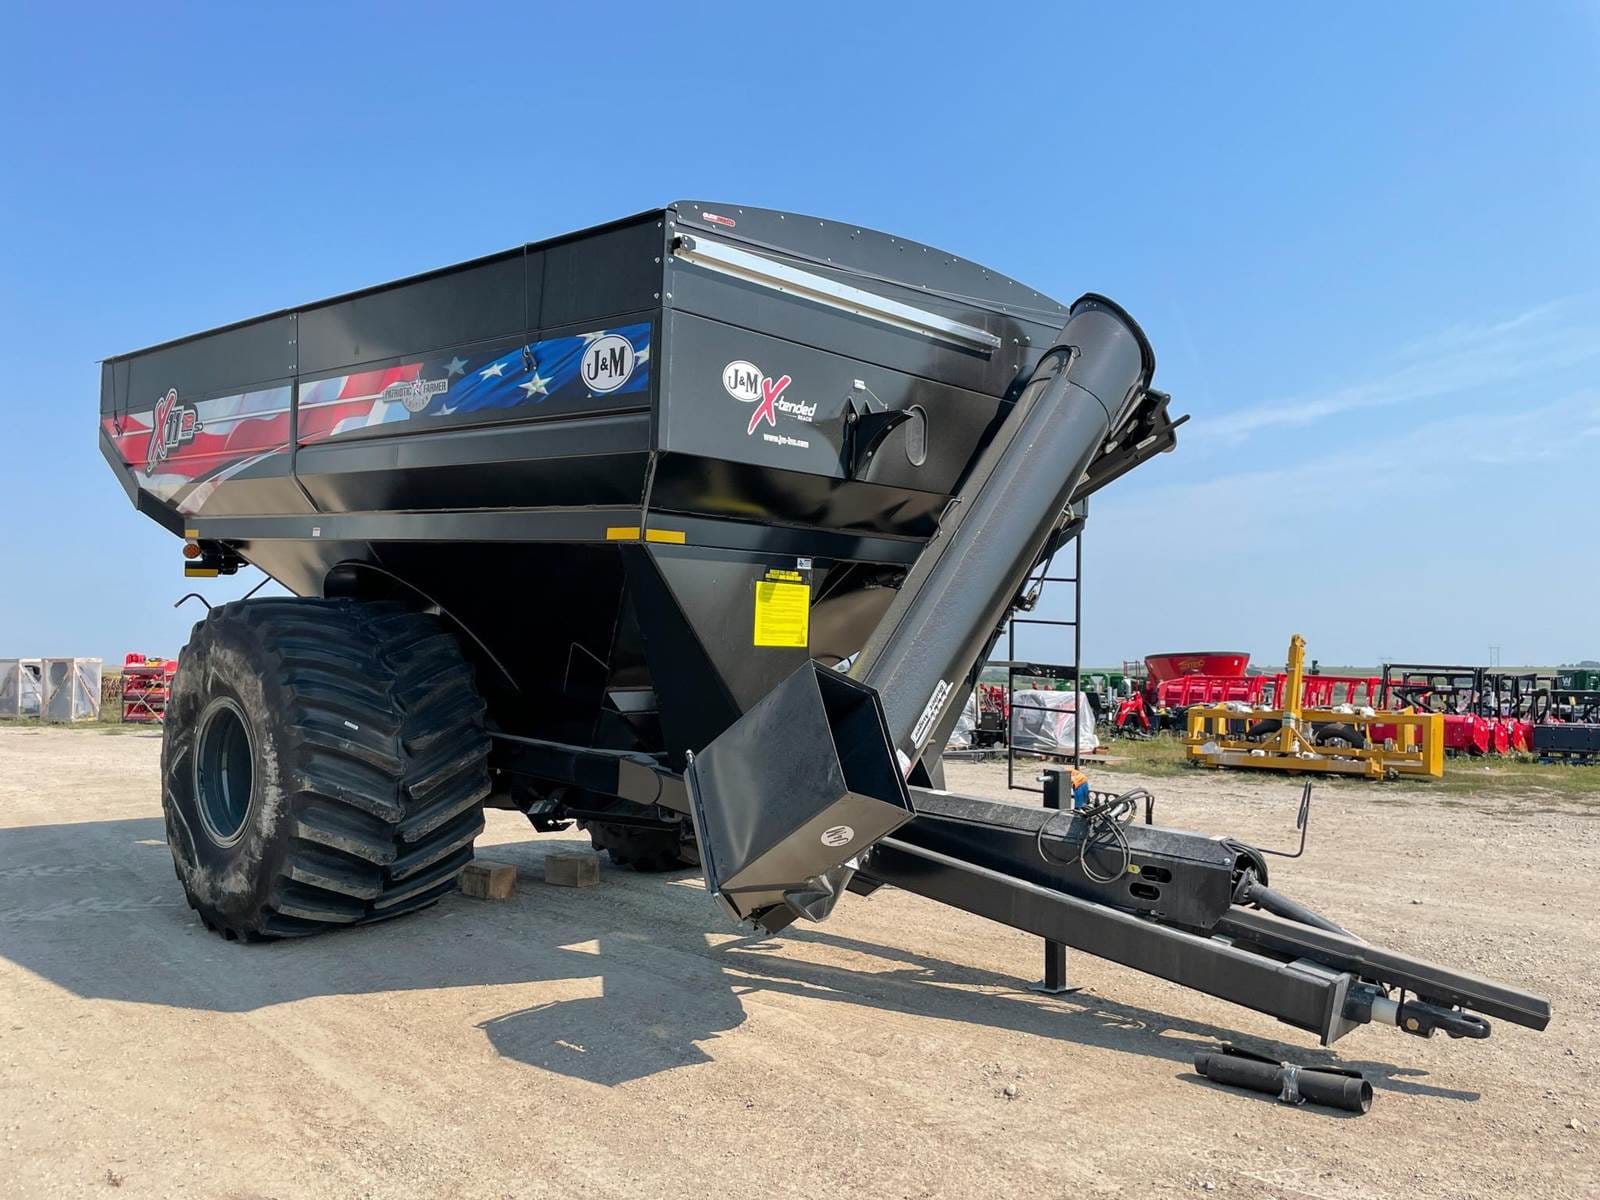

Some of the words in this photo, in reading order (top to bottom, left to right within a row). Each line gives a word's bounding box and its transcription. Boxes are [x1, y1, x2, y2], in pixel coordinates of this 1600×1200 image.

[587, 345, 626, 381] J&M
[423, 381, 447, 394] FARMER
[728, 368, 759, 395] J&M
